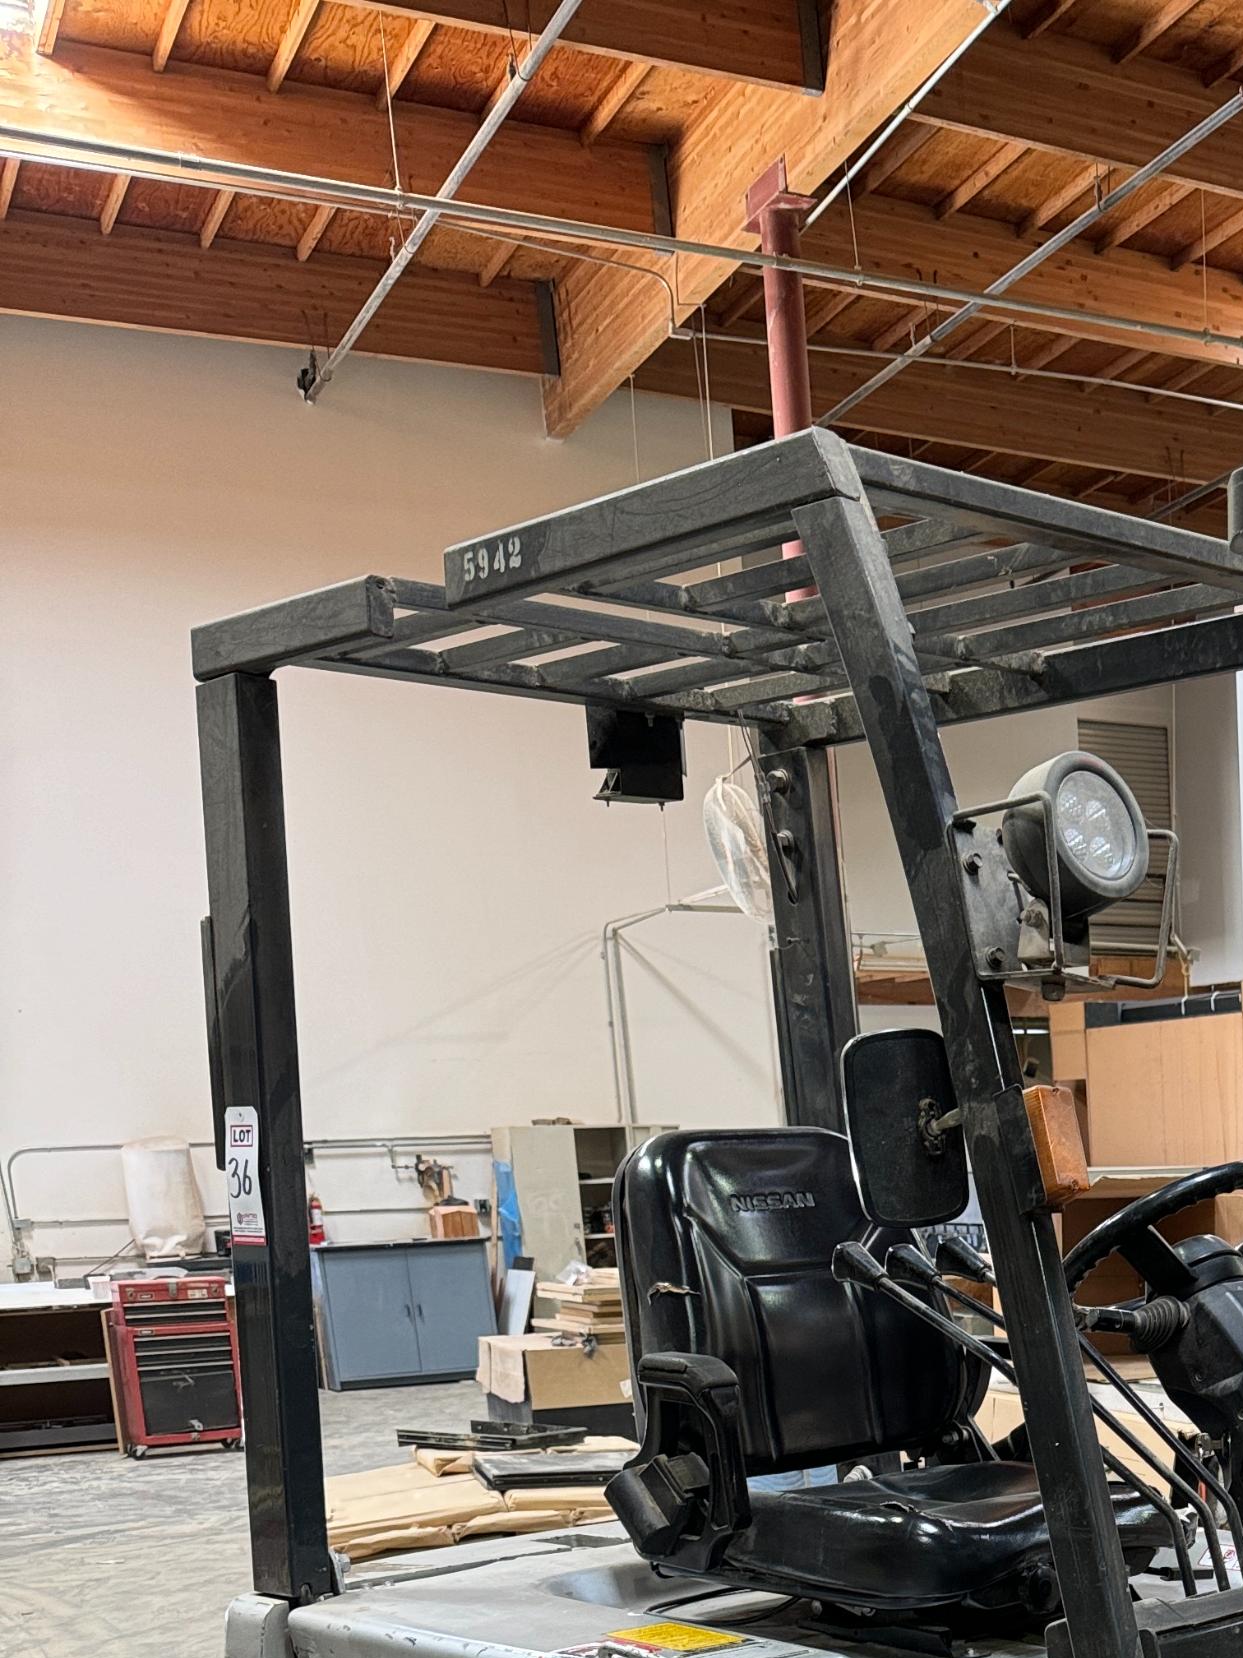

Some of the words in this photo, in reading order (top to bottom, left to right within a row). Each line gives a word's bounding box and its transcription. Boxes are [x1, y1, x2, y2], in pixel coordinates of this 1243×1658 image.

[463, 536, 522, 581] 5942
[233, 1129, 252, 1143] LOT
[228, 1157, 253, 1199] 36
[729, 1191, 816, 1213] NISSAN
